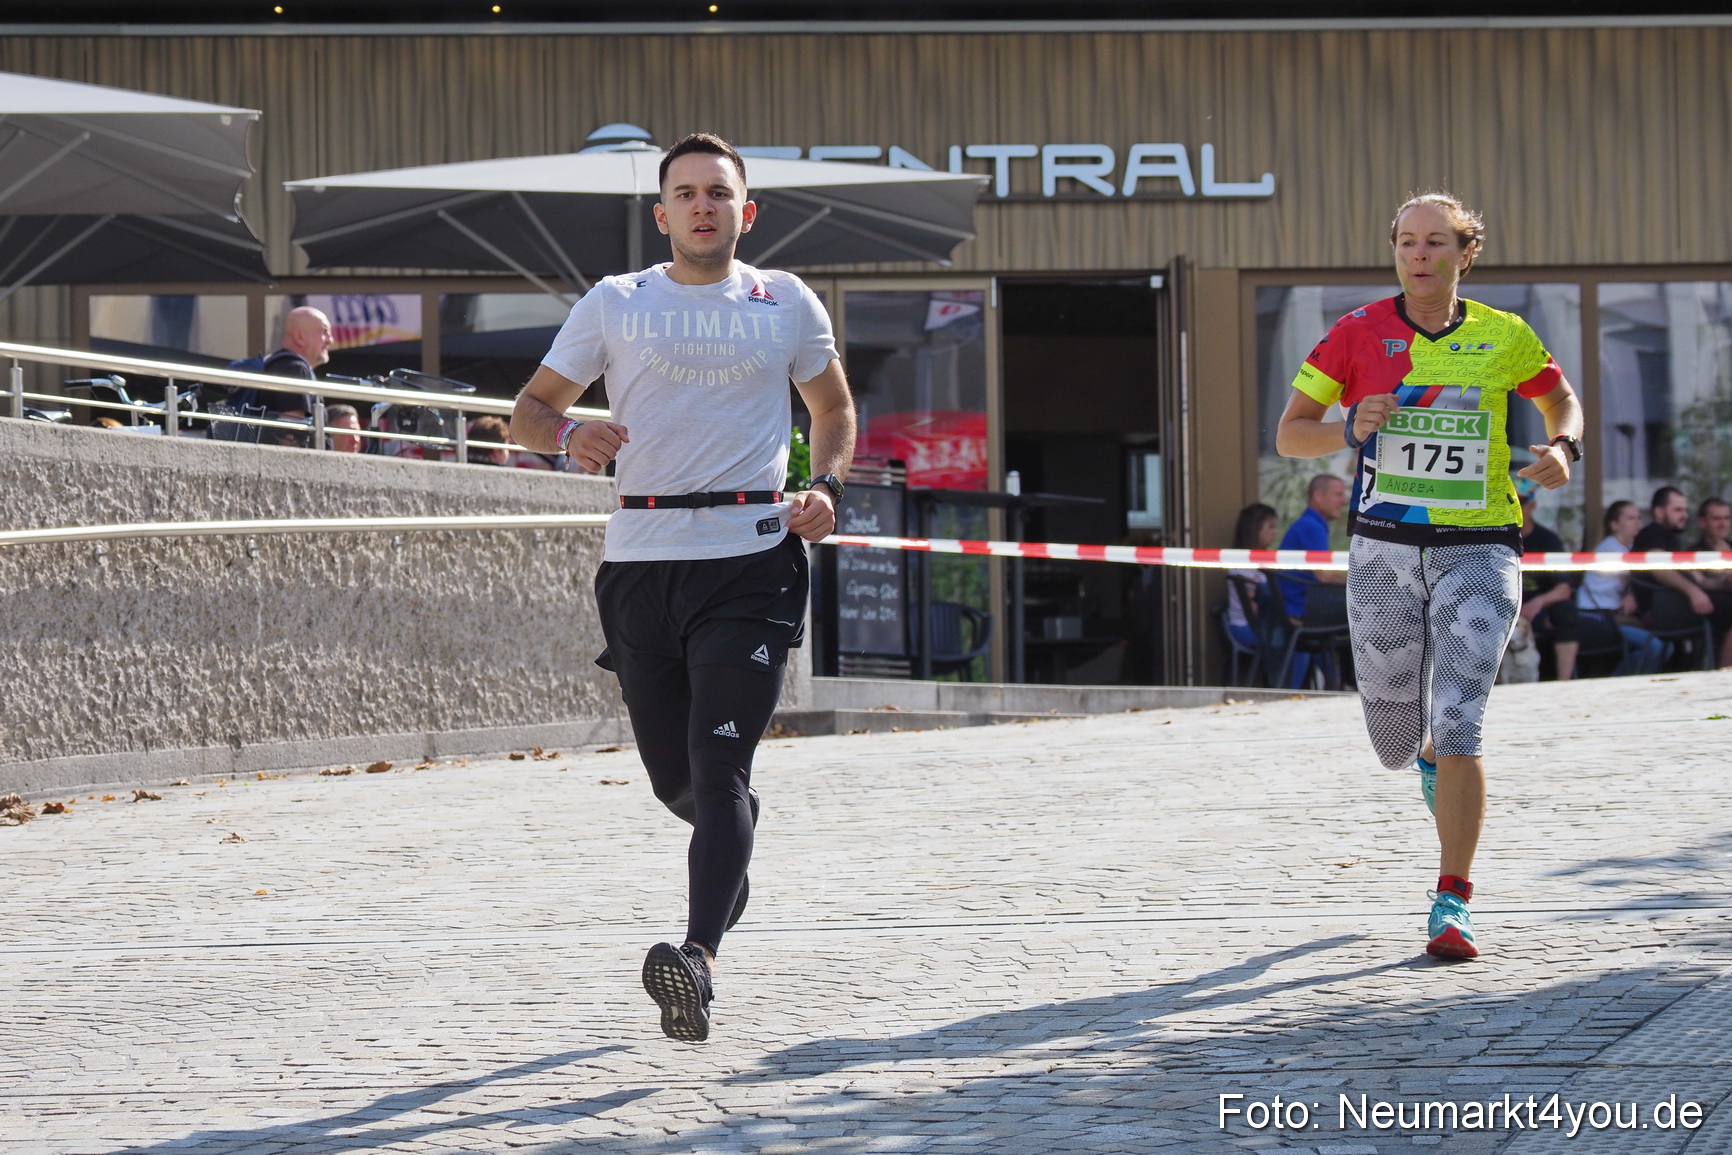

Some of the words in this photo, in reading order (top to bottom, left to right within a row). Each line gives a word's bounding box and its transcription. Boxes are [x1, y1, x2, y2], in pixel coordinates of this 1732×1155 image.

[734, 143, 1275, 196] TRAL
[748, 296, 779, 307] Reebok
[622, 310, 784, 343] ULTIMATE
[673, 343, 736, 356] FIGHTING
[639, 346, 768, 387] CHAMPIONSHIP
[1388, 411, 1480, 435] BOCK
[1401, 442, 1465, 474] 175
[1386, 478, 1435, 494] ANDREA
[751, 653, 770, 666] Reebok
[713, 729, 740, 738] adidas
